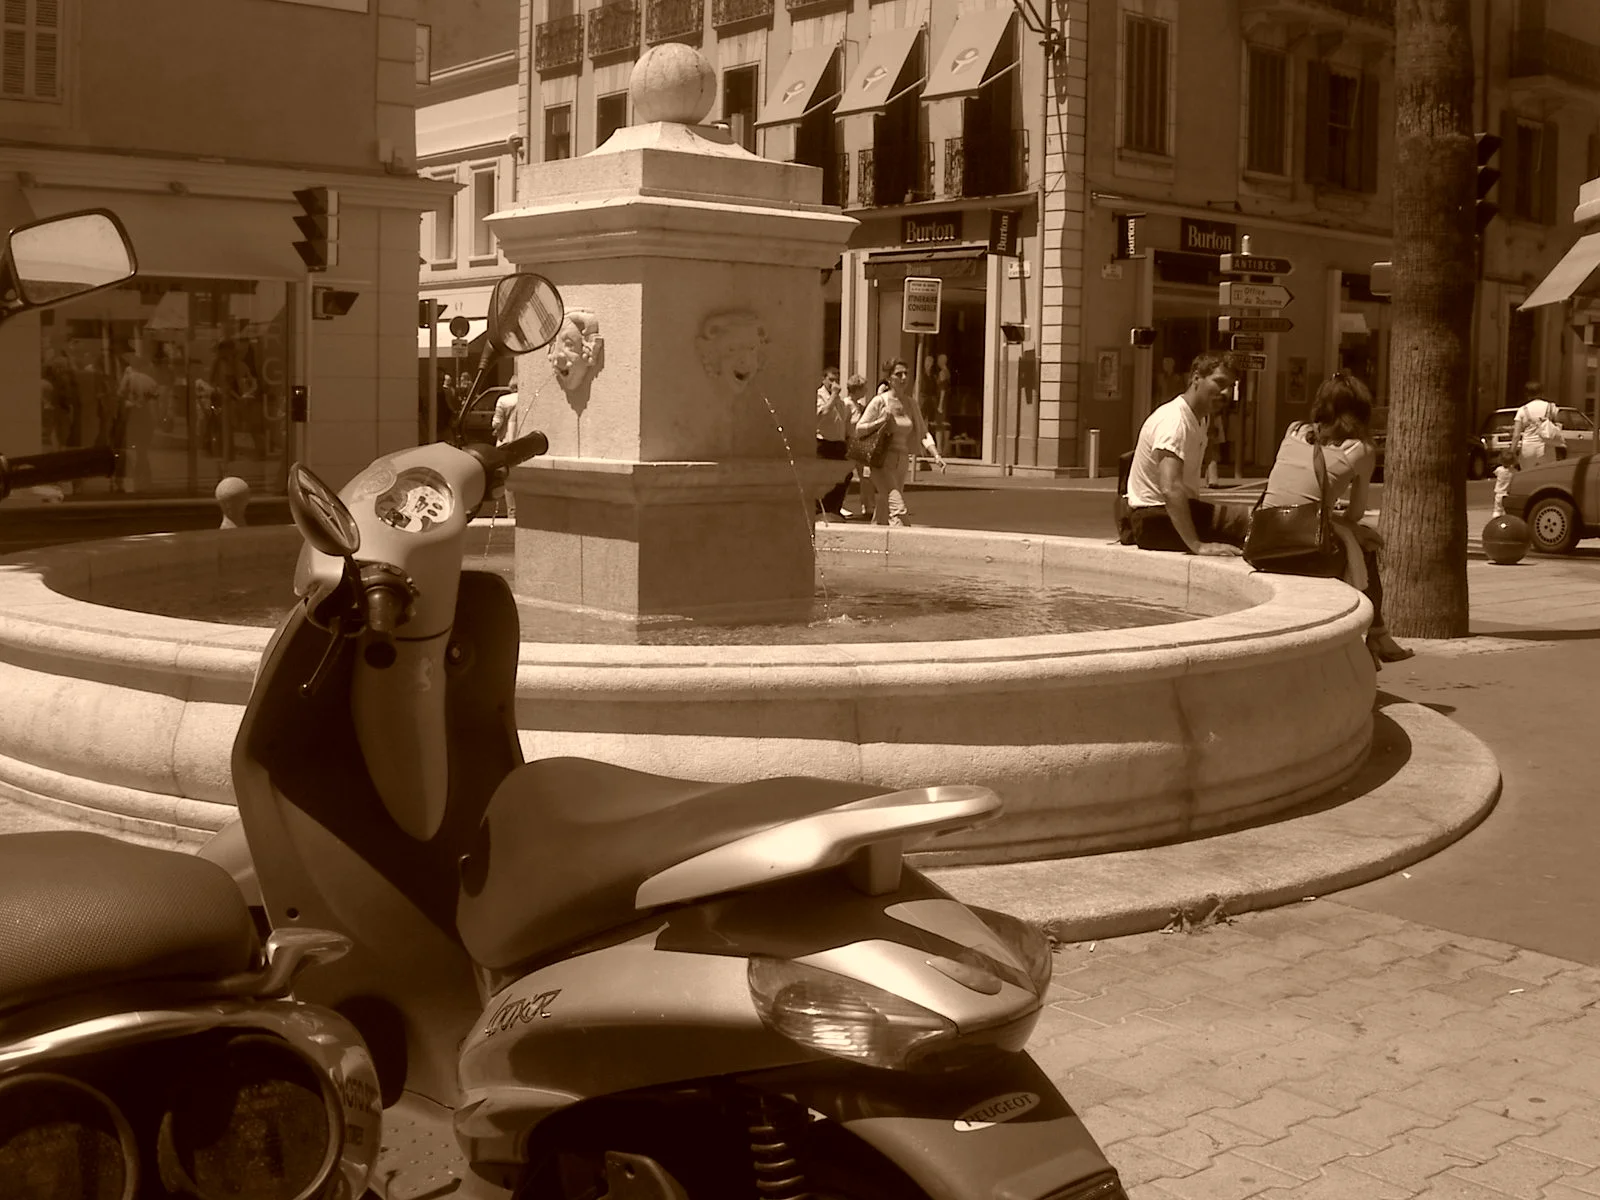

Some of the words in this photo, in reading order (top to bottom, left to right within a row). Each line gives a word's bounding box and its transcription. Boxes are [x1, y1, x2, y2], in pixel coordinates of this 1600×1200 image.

[905, 220, 955, 243] Burton
[997, 214, 1009, 252] Burton
[1187, 224, 1232, 250] Burton
[1233, 259, 1277, 271] ANTIBES
[963, 1094, 1032, 1127] PEUGEOT
